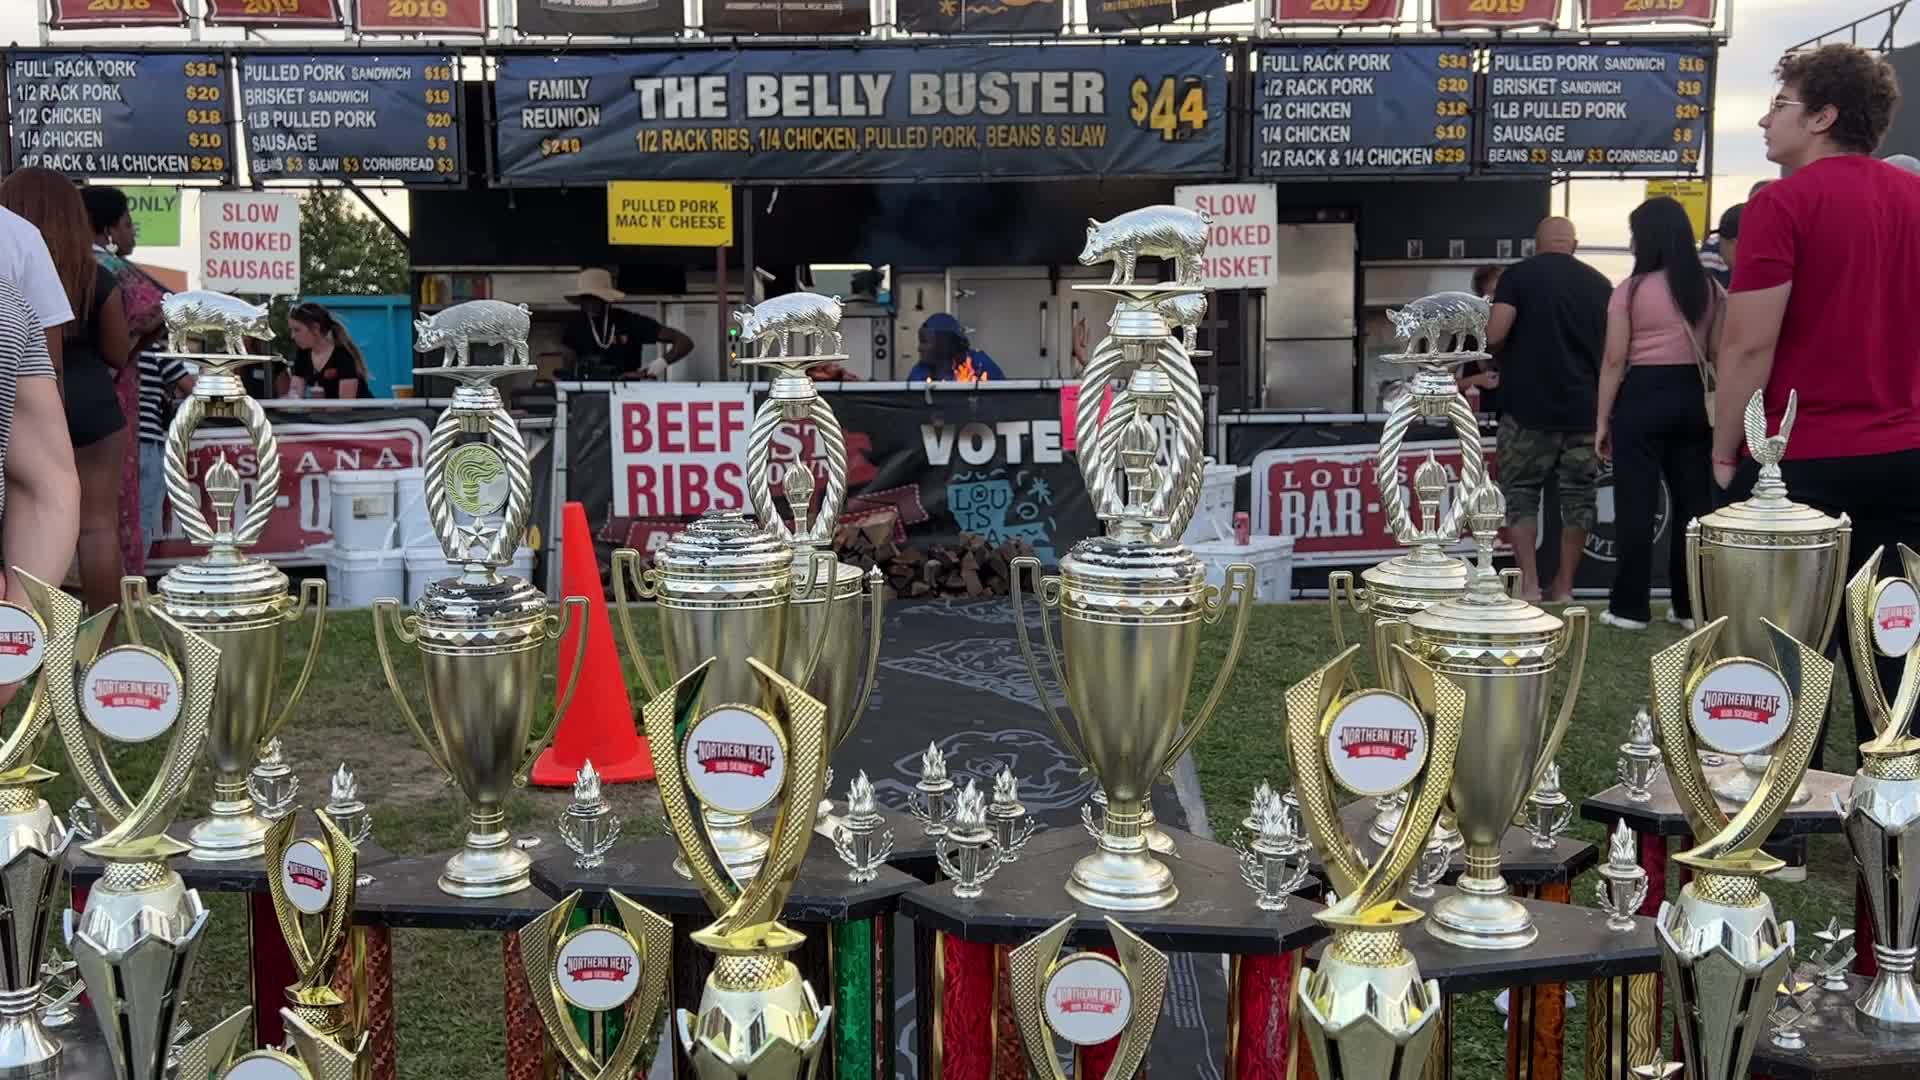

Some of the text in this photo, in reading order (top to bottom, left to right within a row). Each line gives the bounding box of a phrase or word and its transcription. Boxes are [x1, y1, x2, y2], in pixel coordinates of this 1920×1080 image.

[388, 0, 448, 17] 2019
[1469, 0, 1526, 12] 2019
[15, 60, 217, 78] FULL RACK PORK $34
[1262, 54, 1468, 72] FULL RACK PORK $34
[1494, 55, 1553, 72] PULLED
[1556, 54, 1599, 71] PORK
[1604, 57, 1666, 71] SANDWICH
[244, 64, 300, 82] PULLED
[303, 64, 345, 80] PORK
[351, 67, 411, 80] SANDWICH
[16, 84, 220, 100] 1/2 RACK PORK $20
[528, 78, 590, 100] FAMILY
[1264, 78, 1468, 96] 1/2 RACK PORK $20
[1493, 78, 1558, 95] BRISKET
[1561, 81, 1622, 94] SANDWICH
[246, 88, 450, 105] BRISKET SANDWICH $19
[634, 72, 1208, 141] THE BELLY BUSTER $44
[1262, 102, 1282, 120] 1/2
[1285, 102, 1351, 120] CHICKEN
[1492, 102, 1521, 119] 1LB
[1524, 102, 1580, 118] PULLED
[1584, 102, 1628, 118] PORK
[18, 108, 220, 124] 1/2 CHICKEN $18
[248, 111, 450, 129] 1LB PULLED PORK $20
[522, 107, 600, 128] REUNION
[20, 132, 221, 148] 1/4 CHICKEN $10
[635, 125, 1107, 152] 1/2 RACK RIBS, 1/4 CHICKEN, PULLED PORK, BEANS & SLAW
[1262, 126, 1466, 143] 1/4 CHICKEN $10
[1493, 125, 1566, 142] SAUSAGE
[252, 134, 318, 152] SAUSAGE
[42, 154, 83, 171] RACK
[86, 155, 96, 171] &
[99, 155, 118, 171] 1/4
[127, 155, 188, 172] CHICKEN
[190, 157, 224, 171] $29
[1261, 148, 1465, 167] 1/2 RACK & 1/4 CHICKEN $29
[1488, 149, 1697, 163] BEANS $3 SLAW $3 CORNBREAD $3
[252, 158, 454, 173] BEANS $3 SLAW $3 CORNBREAD $3
[127, 196, 176, 212] ONLY
[222, 203, 279, 222] SLOW
[622, 198, 719, 214] PULLED PORK
[1194, 193, 1256, 216] SLOW
[616, 214, 647, 228] MAC
[670, 216, 726, 229] CHEESE
[209, 232, 292, 252] SMOKED
[206, 259, 296, 280] SAUSAGE
[1201, 255, 1272, 278] RISKET
[622, 401, 745, 454] BEEF
[920, 420, 1063, 466] VOTE
[626, 462, 745, 516] RIBS
[96, 680, 168, 701] NORTHERN HEAT
[1705, 691, 1778, 714] NORTHERN HEAT
[1342, 728, 1415, 751] NORTHERN HEAT
[698, 741, 772, 767] NORTHERN HEAT
[568, 957, 630, 974] NORTHERN HEAT
[1056, 988, 1120, 1007] NORTHERN HEAT
